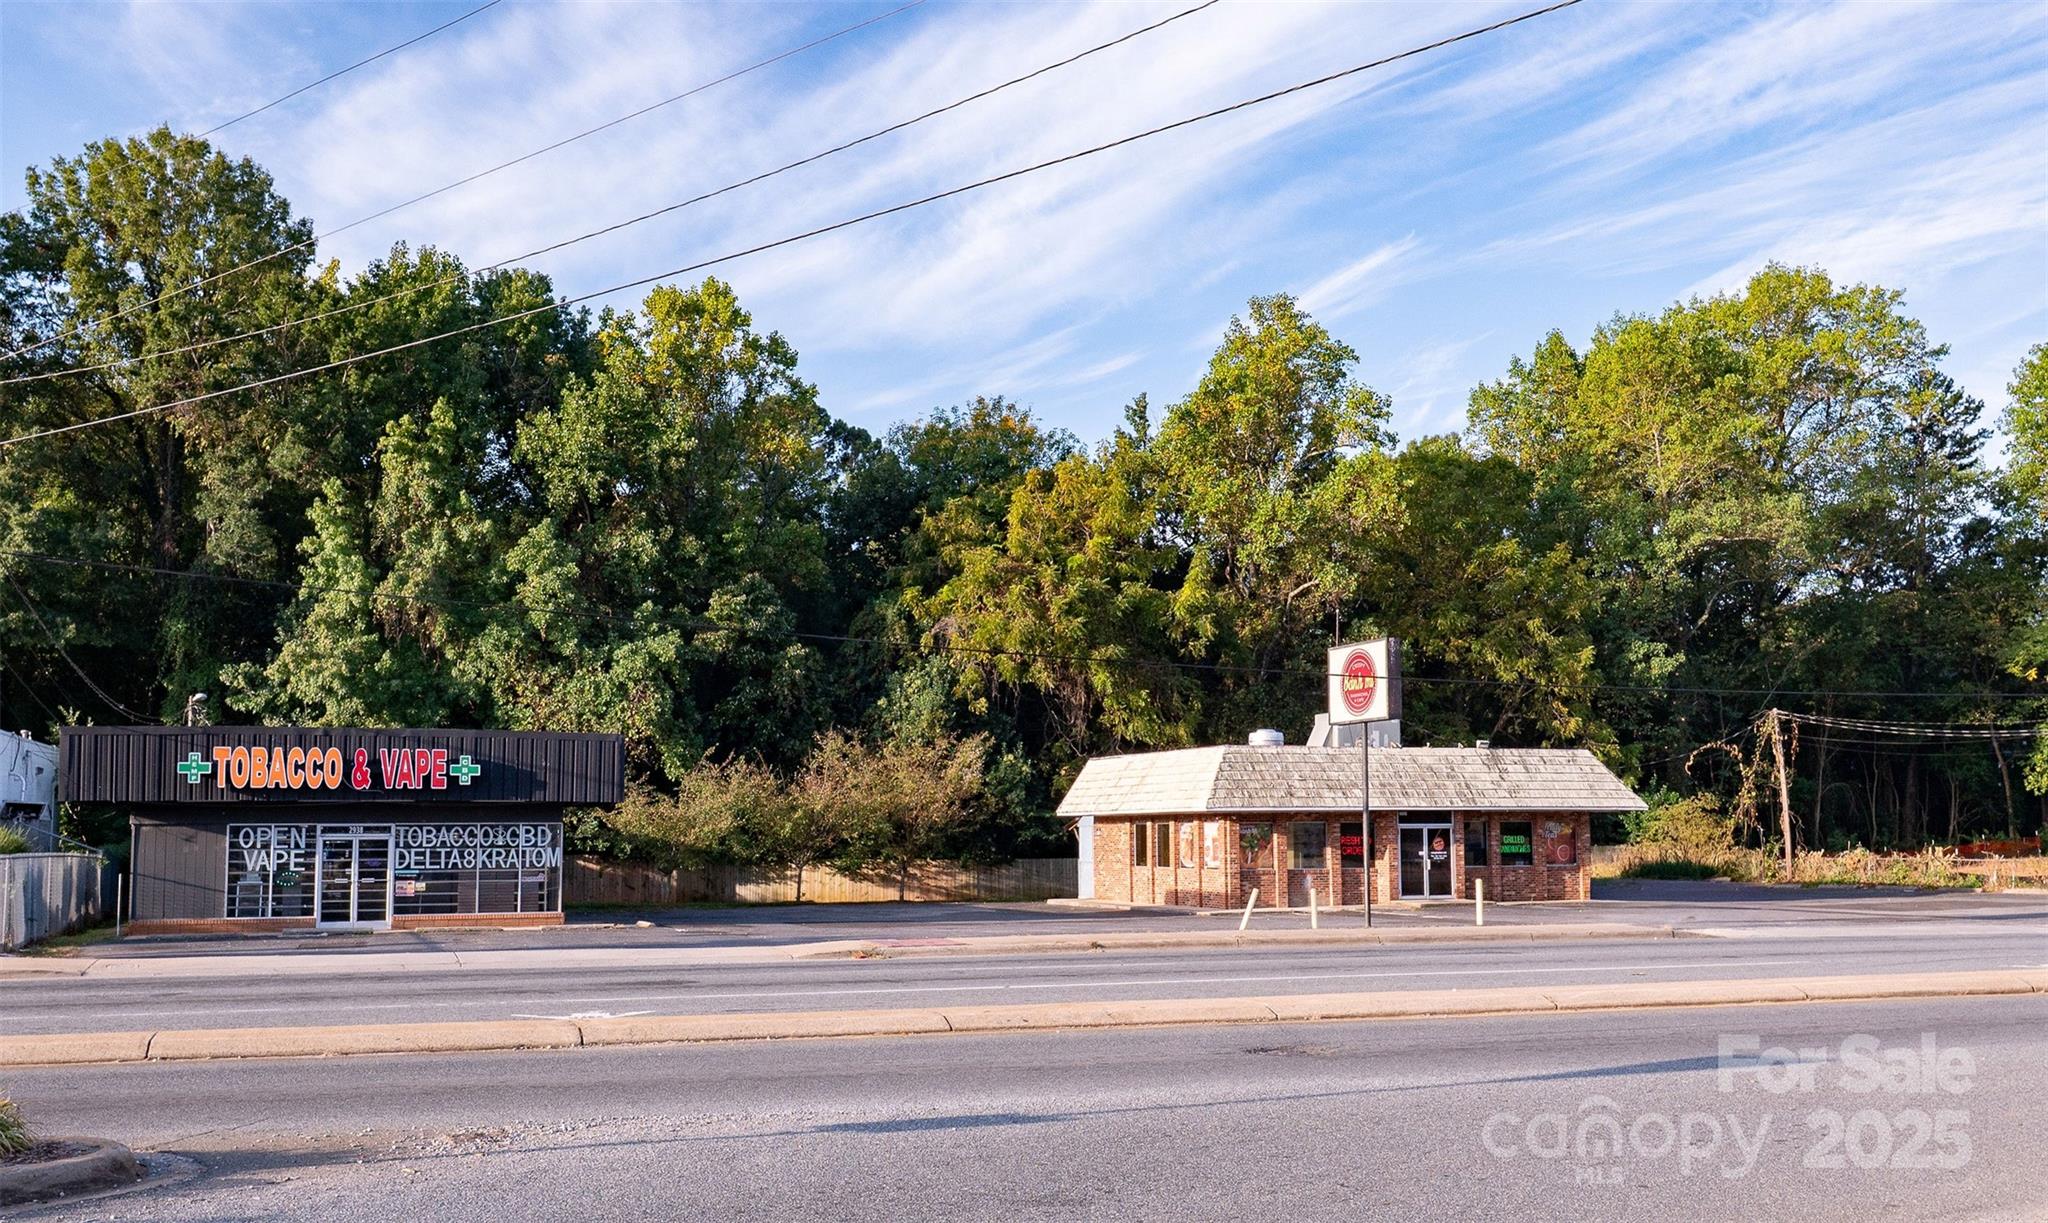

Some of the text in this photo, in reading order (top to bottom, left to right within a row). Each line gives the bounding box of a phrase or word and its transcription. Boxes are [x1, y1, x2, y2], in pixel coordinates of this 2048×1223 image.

[191, 754, 199, 782] HEMP
[213, 746, 448, 790] TOBACCO & VAPE
[461, 758, 470, 782] CBD
[239, 827, 306, 848] OPEN
[348, 826, 364, 834] 2938
[396, 826, 552, 847] TOBACCO CBD
[242, 849, 306, 871] VAPE
